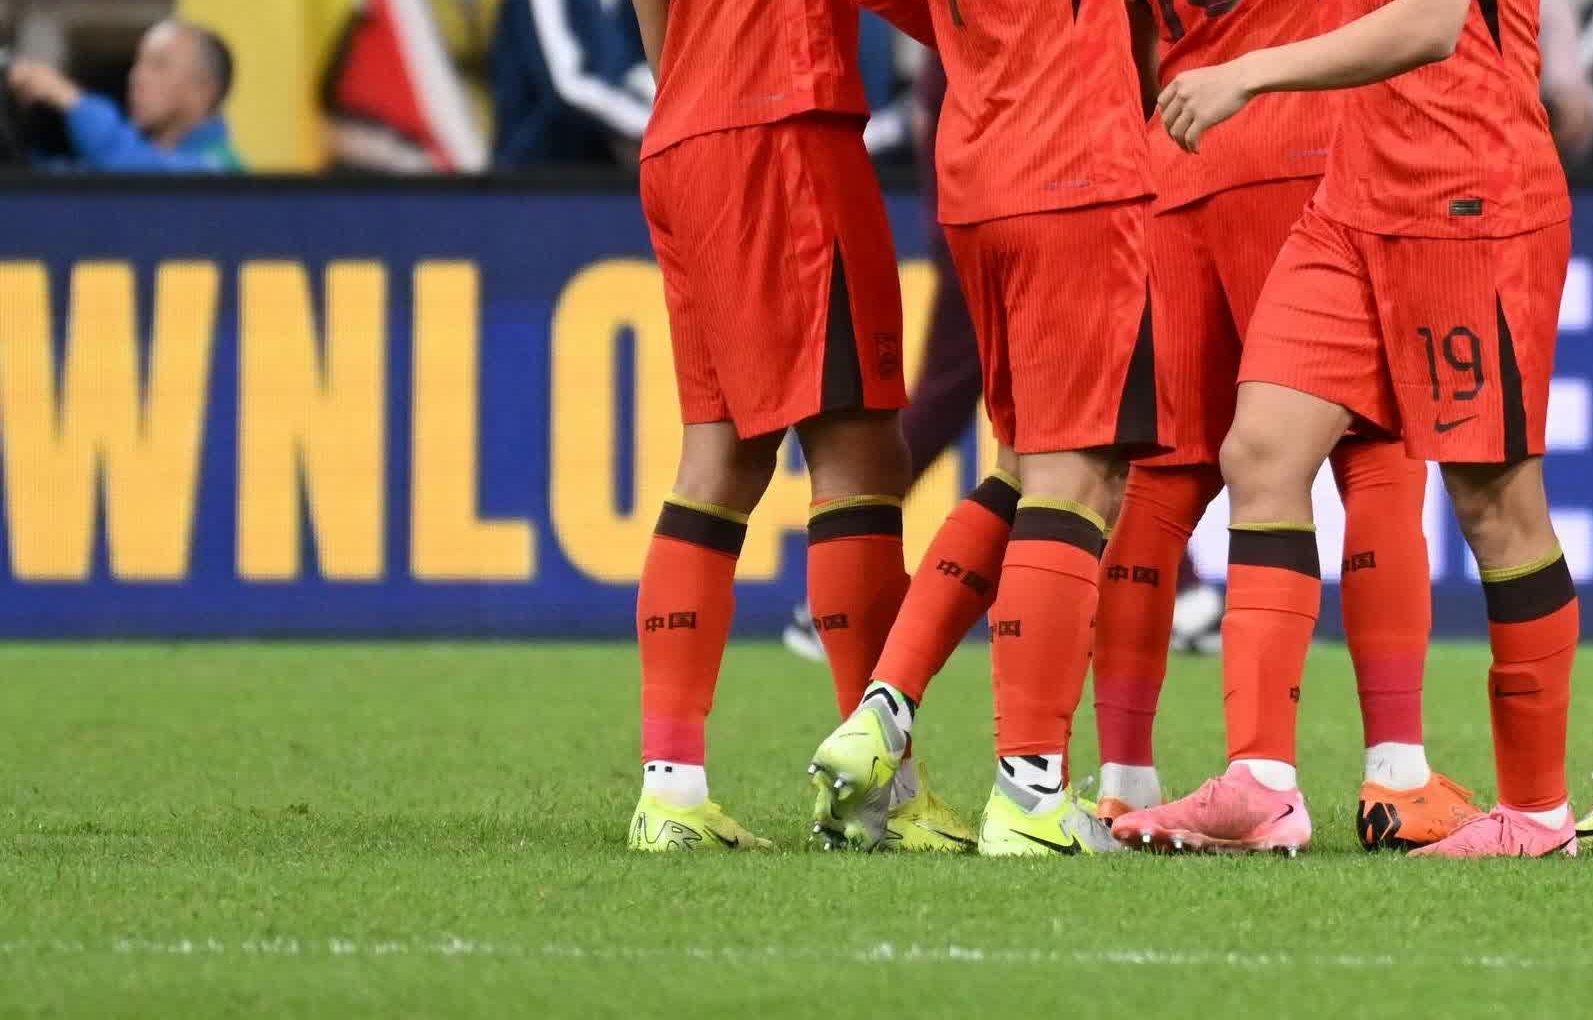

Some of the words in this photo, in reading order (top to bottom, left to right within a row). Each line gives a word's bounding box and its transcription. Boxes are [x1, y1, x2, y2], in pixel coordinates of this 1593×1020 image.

[1416, 325, 1485, 401] 19
[936, 559, 992, 597] 中国
[1108, 564, 1160, 588] 中国
[645, 611, 697, 632] 中国
